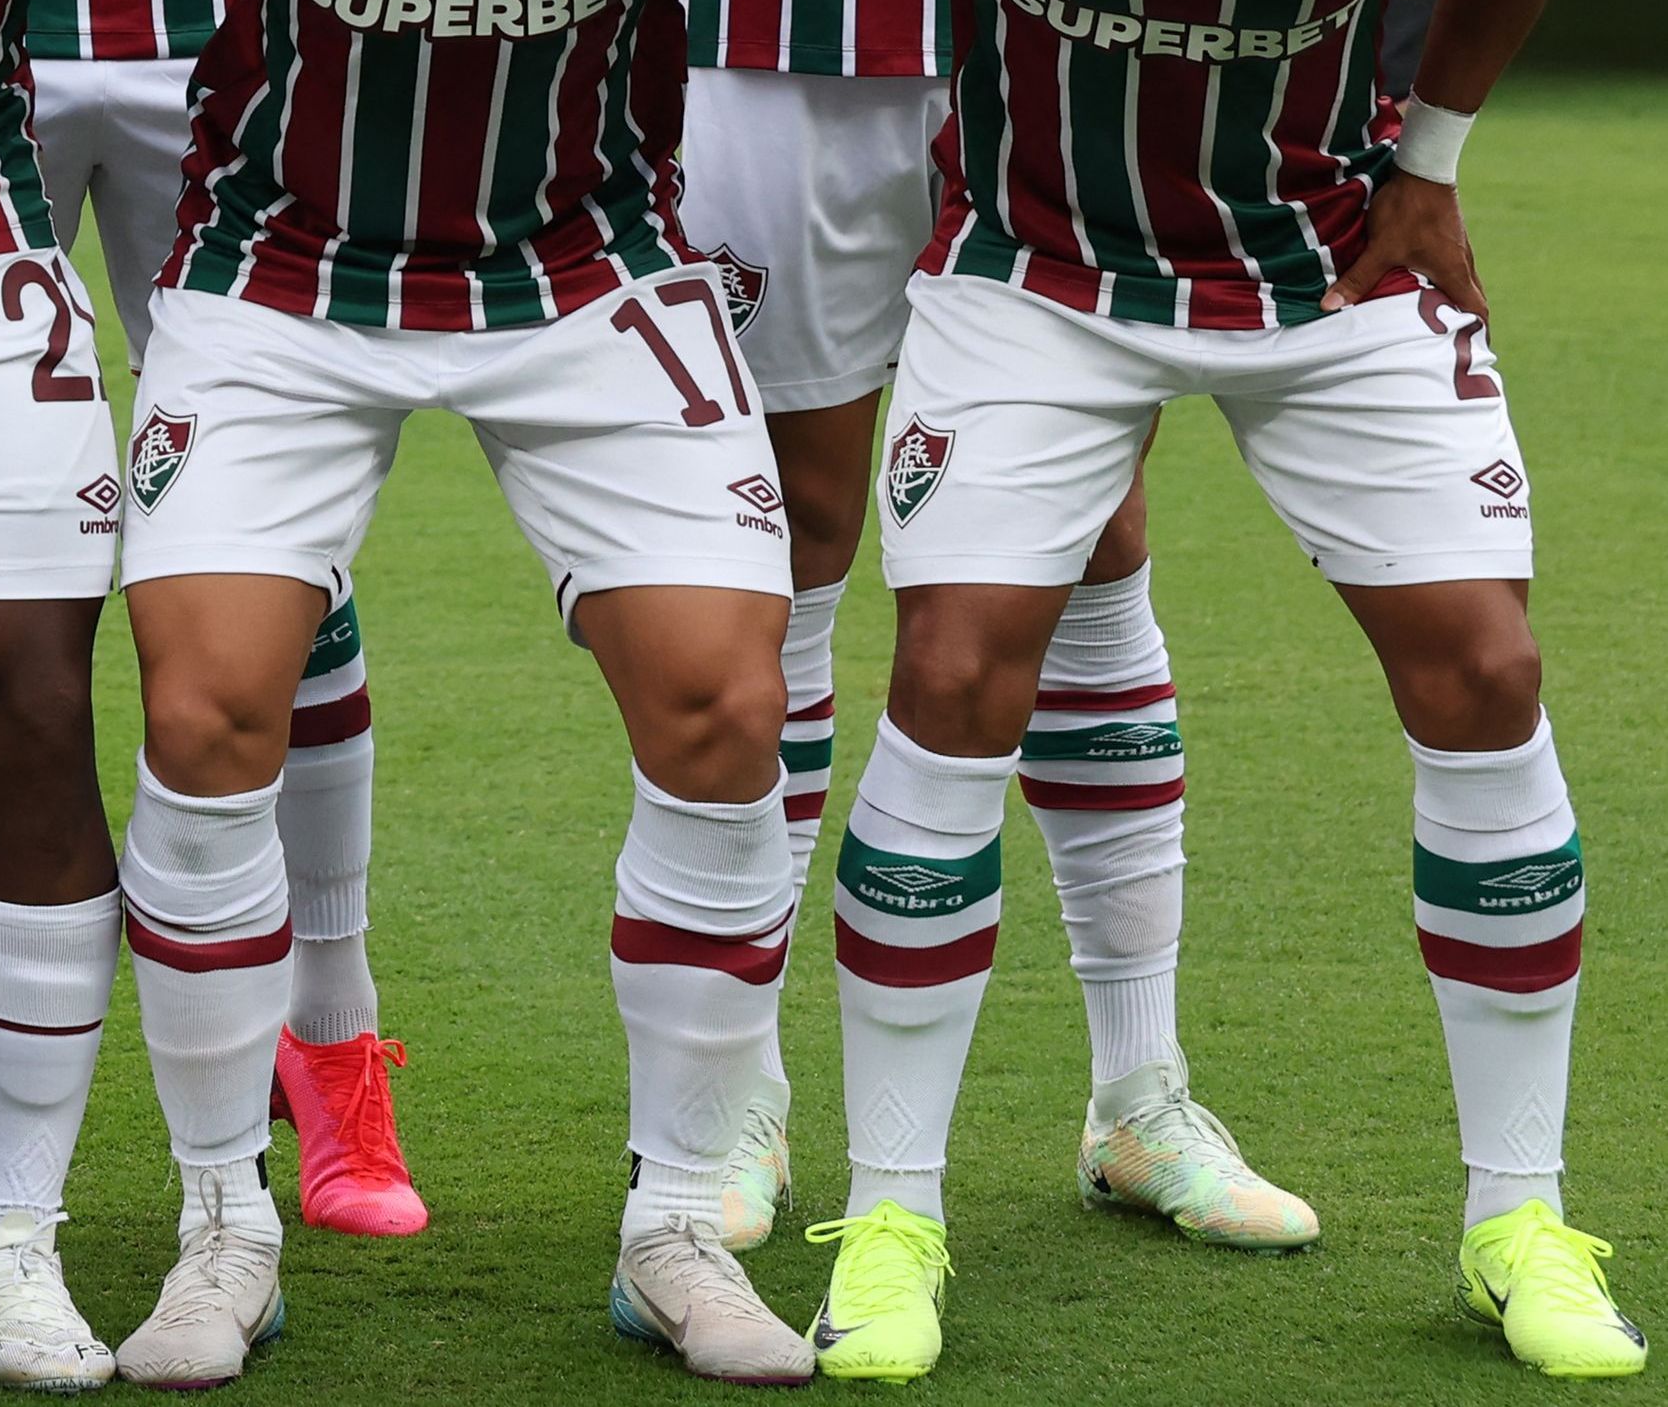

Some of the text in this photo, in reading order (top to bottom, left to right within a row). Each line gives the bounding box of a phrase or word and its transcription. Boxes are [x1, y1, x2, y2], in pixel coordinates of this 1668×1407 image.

[3, 255, 107, 402] 2
[609, 278, 751, 428] 17
[736, 513, 784, 540] umbro
[858, 883, 964, 911] umbro
[1478, 874, 1580, 908] umbro
